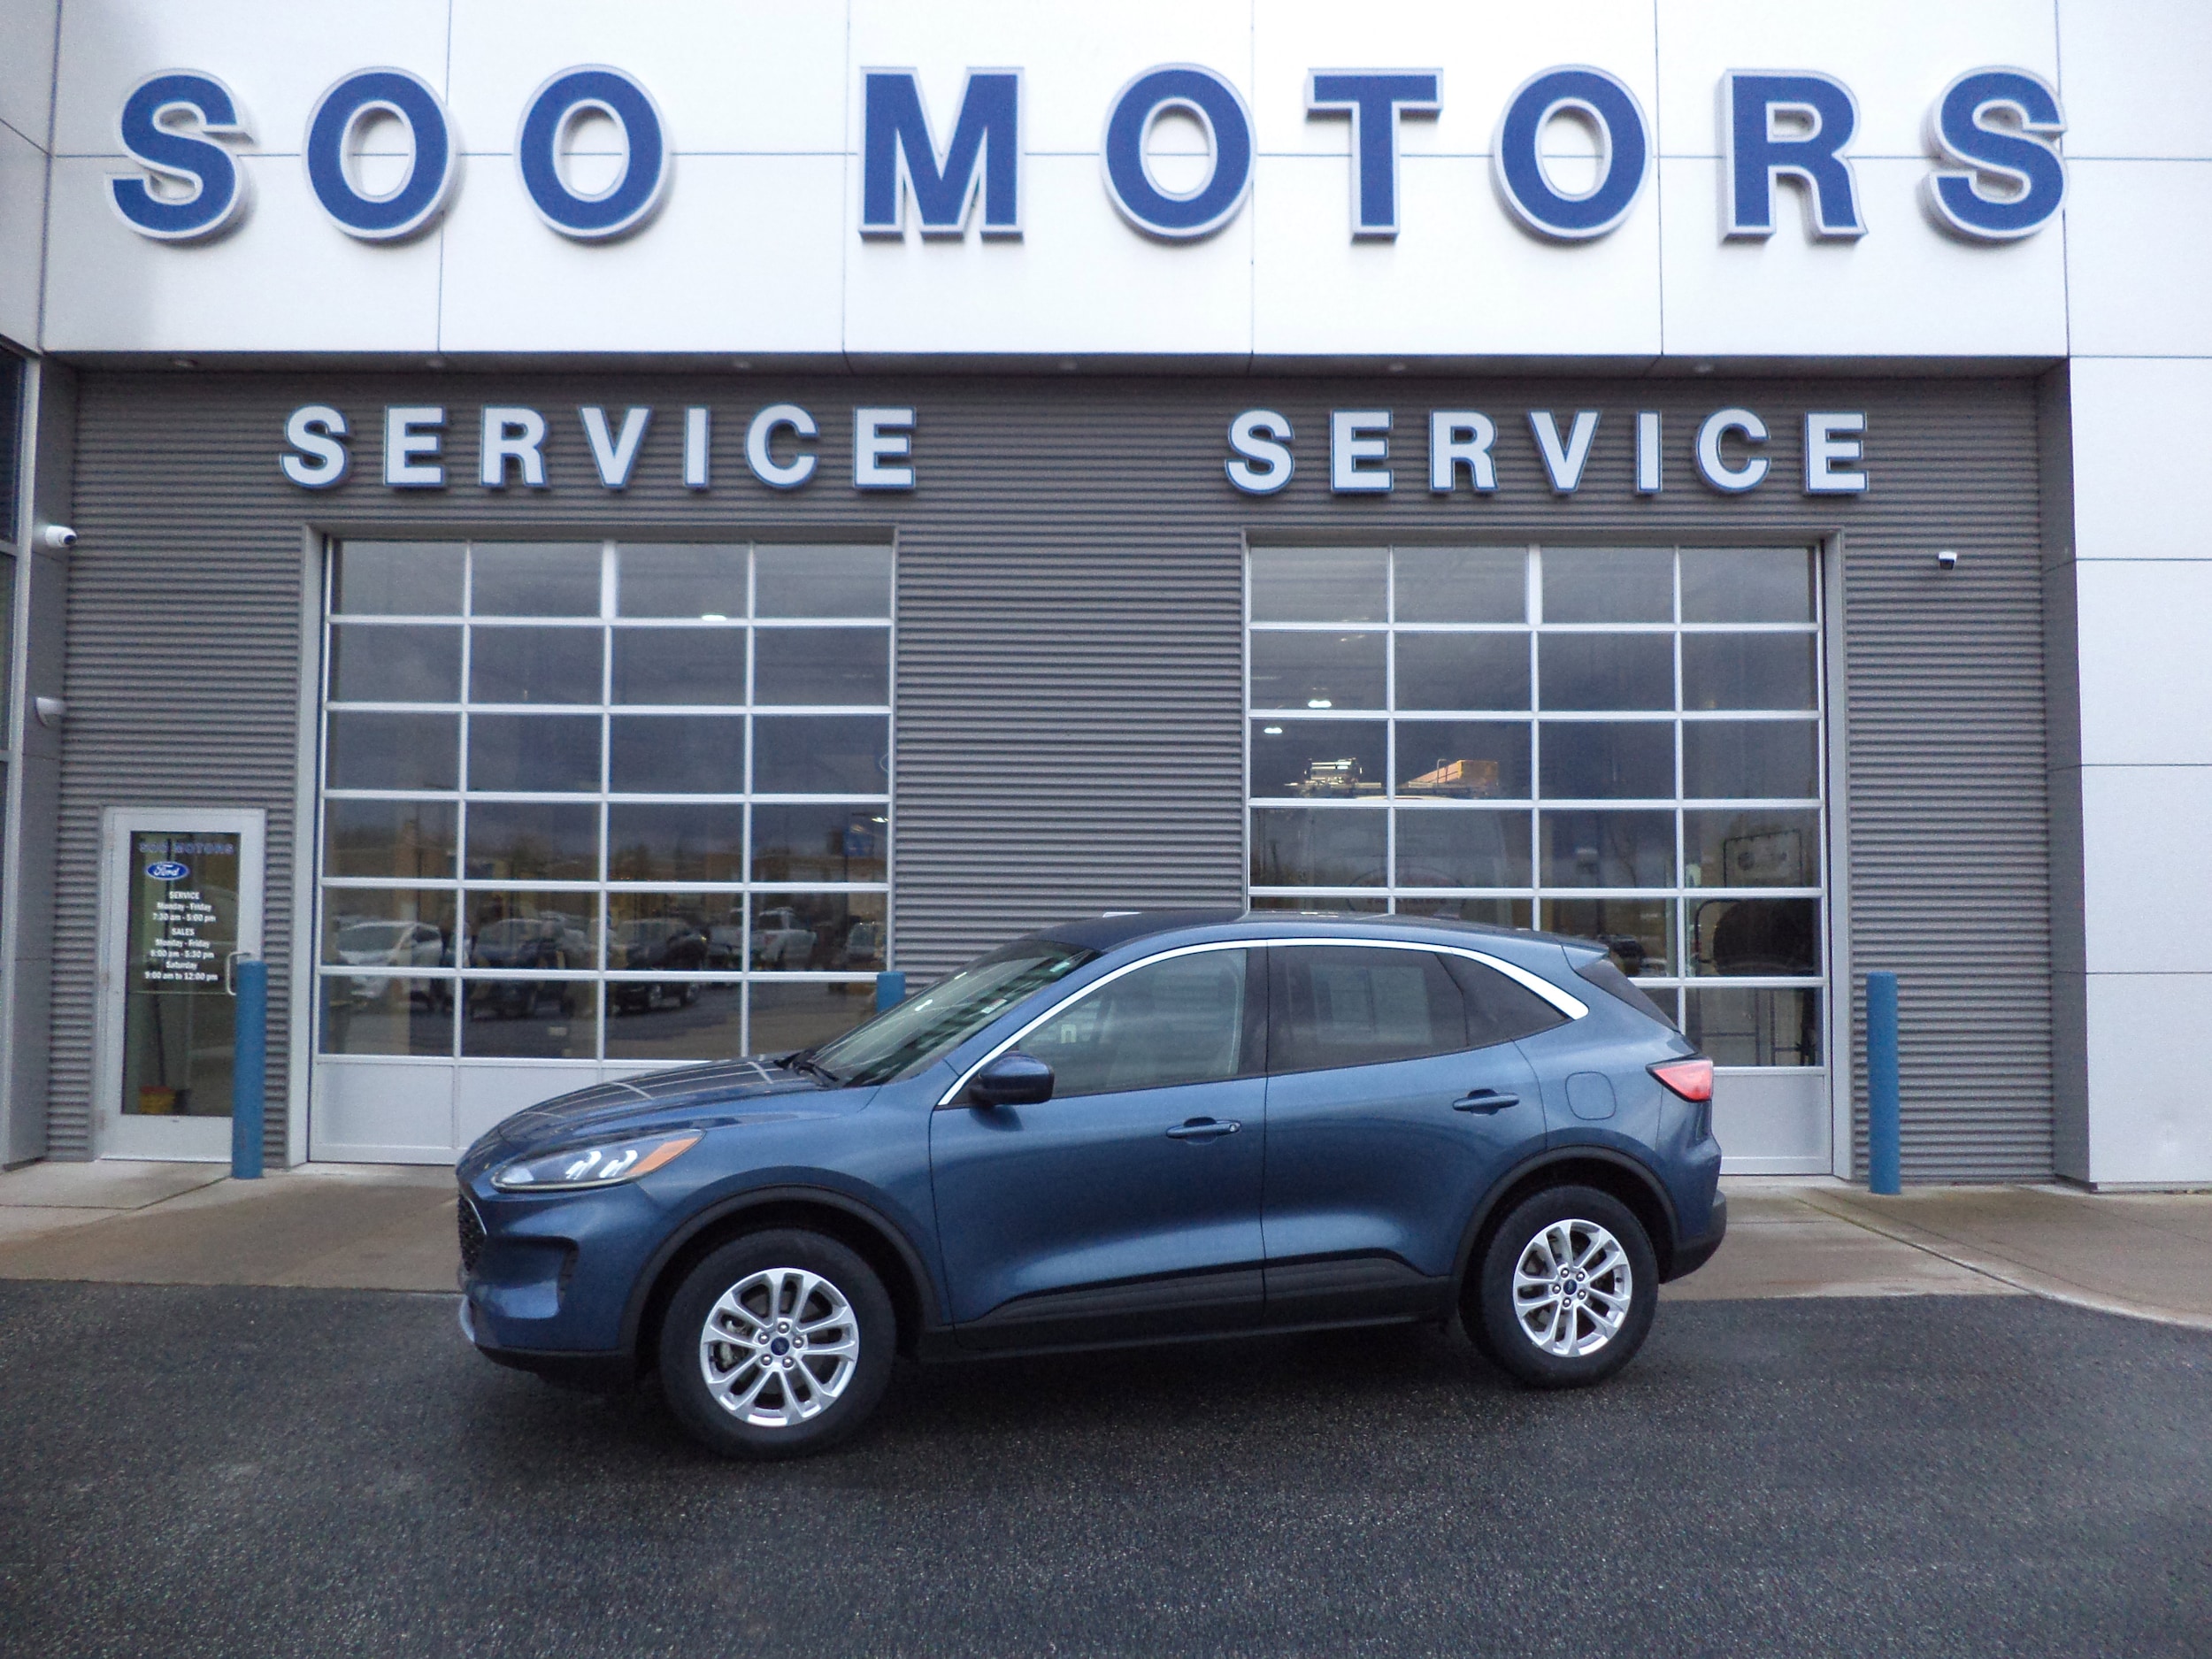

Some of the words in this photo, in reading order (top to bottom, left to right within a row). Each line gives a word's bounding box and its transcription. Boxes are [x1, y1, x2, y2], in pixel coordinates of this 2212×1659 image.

[105, 64, 672, 243] SOO
[859, 62, 2070, 243] MOTORS
[280, 403, 918, 491] SERVICE
[1225, 408, 1870, 496] SERVICE
[169, 891, 200, 900] SERVICE
[157, 902, 184, 911] Monday
[189, 902, 212, 912] Friday
[171, 927, 196, 936] SALES
[165, 960, 197, 970] Saturday
